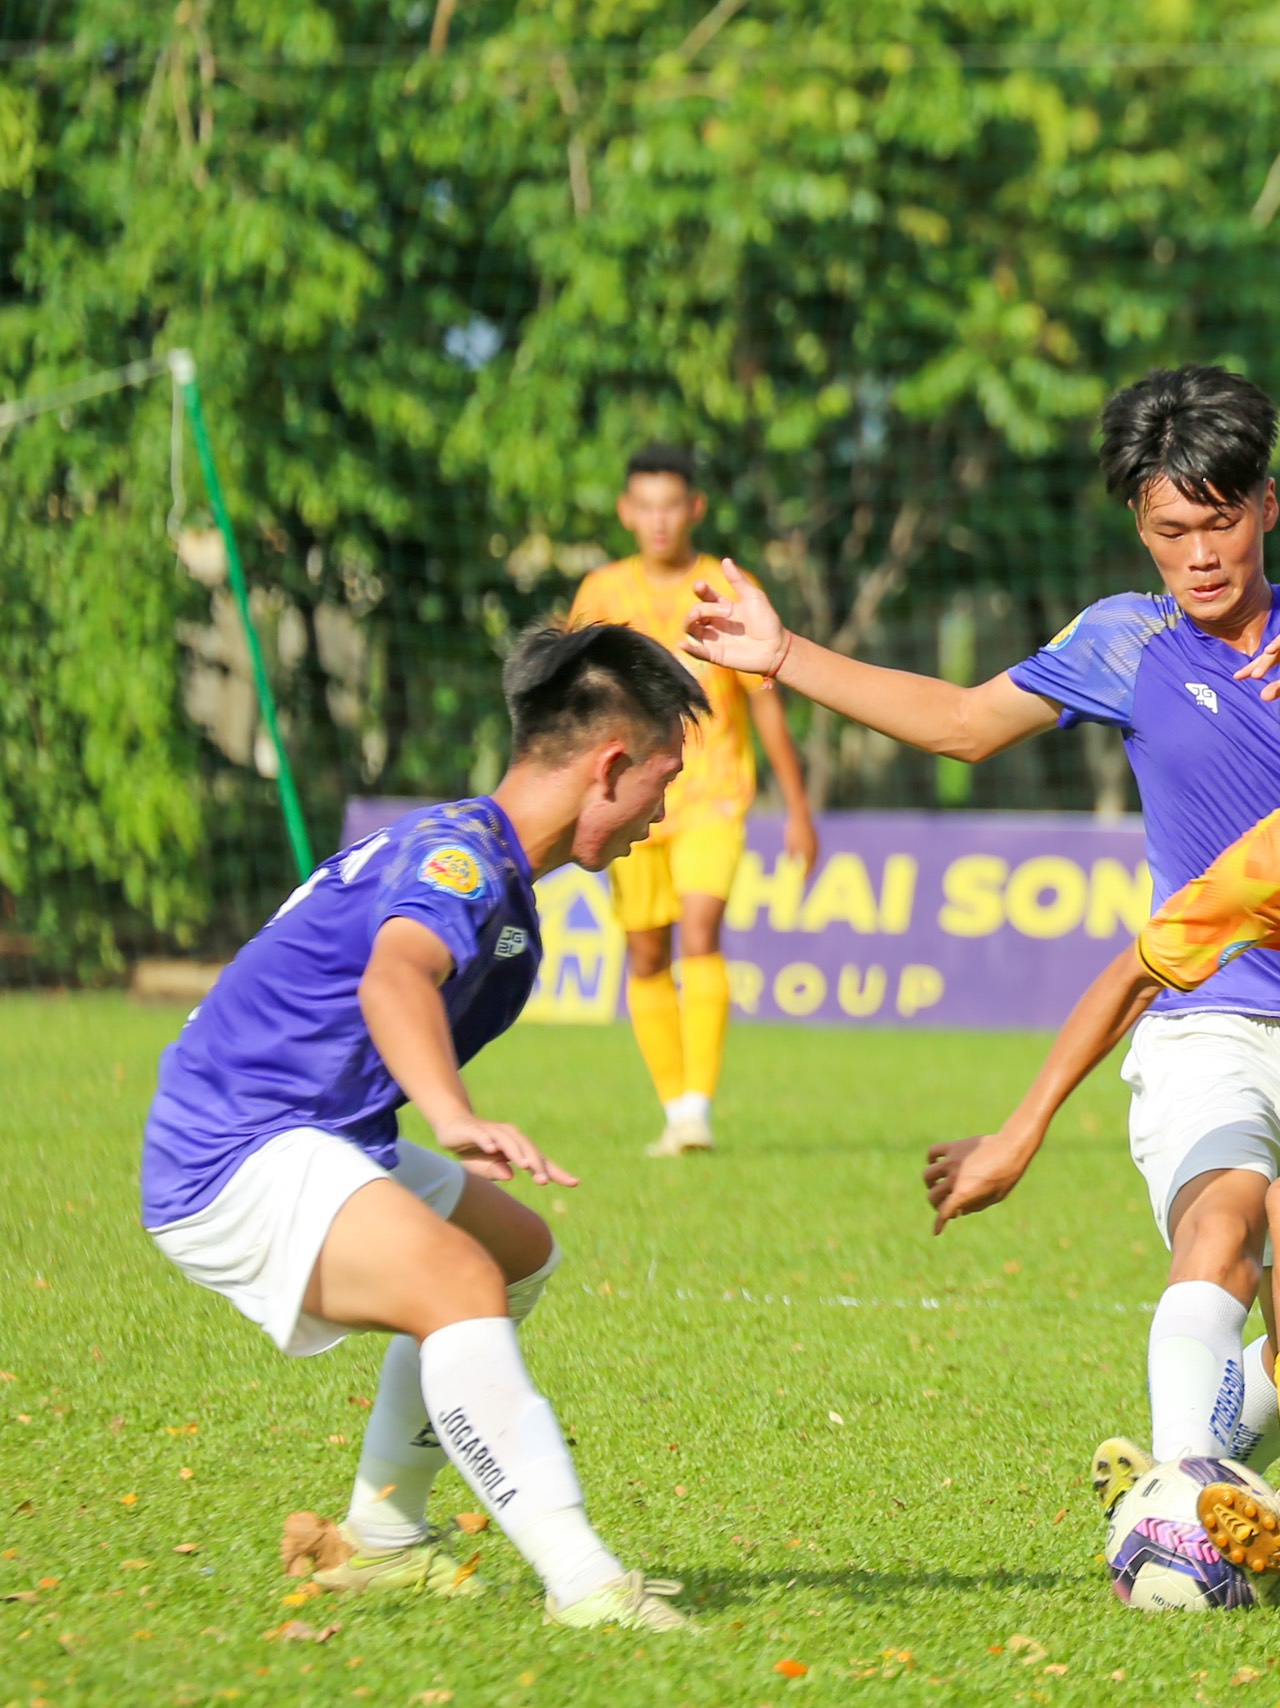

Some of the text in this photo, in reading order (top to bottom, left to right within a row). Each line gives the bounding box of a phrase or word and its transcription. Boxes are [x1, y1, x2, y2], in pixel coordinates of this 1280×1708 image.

[725, 850, 1154, 939] HAI SON
[671, 960, 945, 1018] ROUP
[438, 1406, 518, 1511] JOGARBOLA
